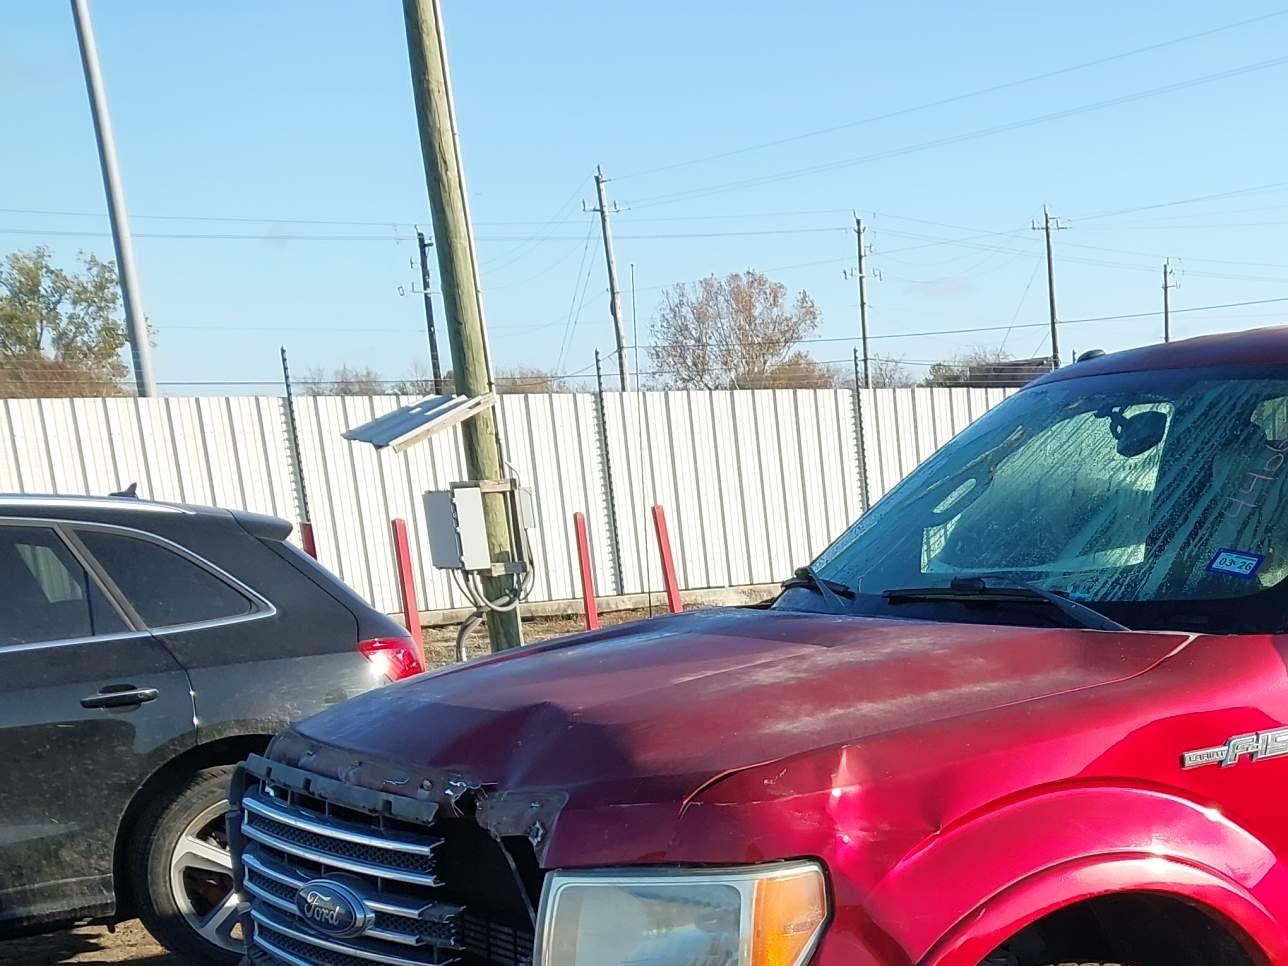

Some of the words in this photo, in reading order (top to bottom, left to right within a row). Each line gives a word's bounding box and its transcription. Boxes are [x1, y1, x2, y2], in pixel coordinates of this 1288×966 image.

[1218, 557, 1233, 567] 03
[1237, 561, 1253, 571] 26
[304, 890, 340, 926] Ford
